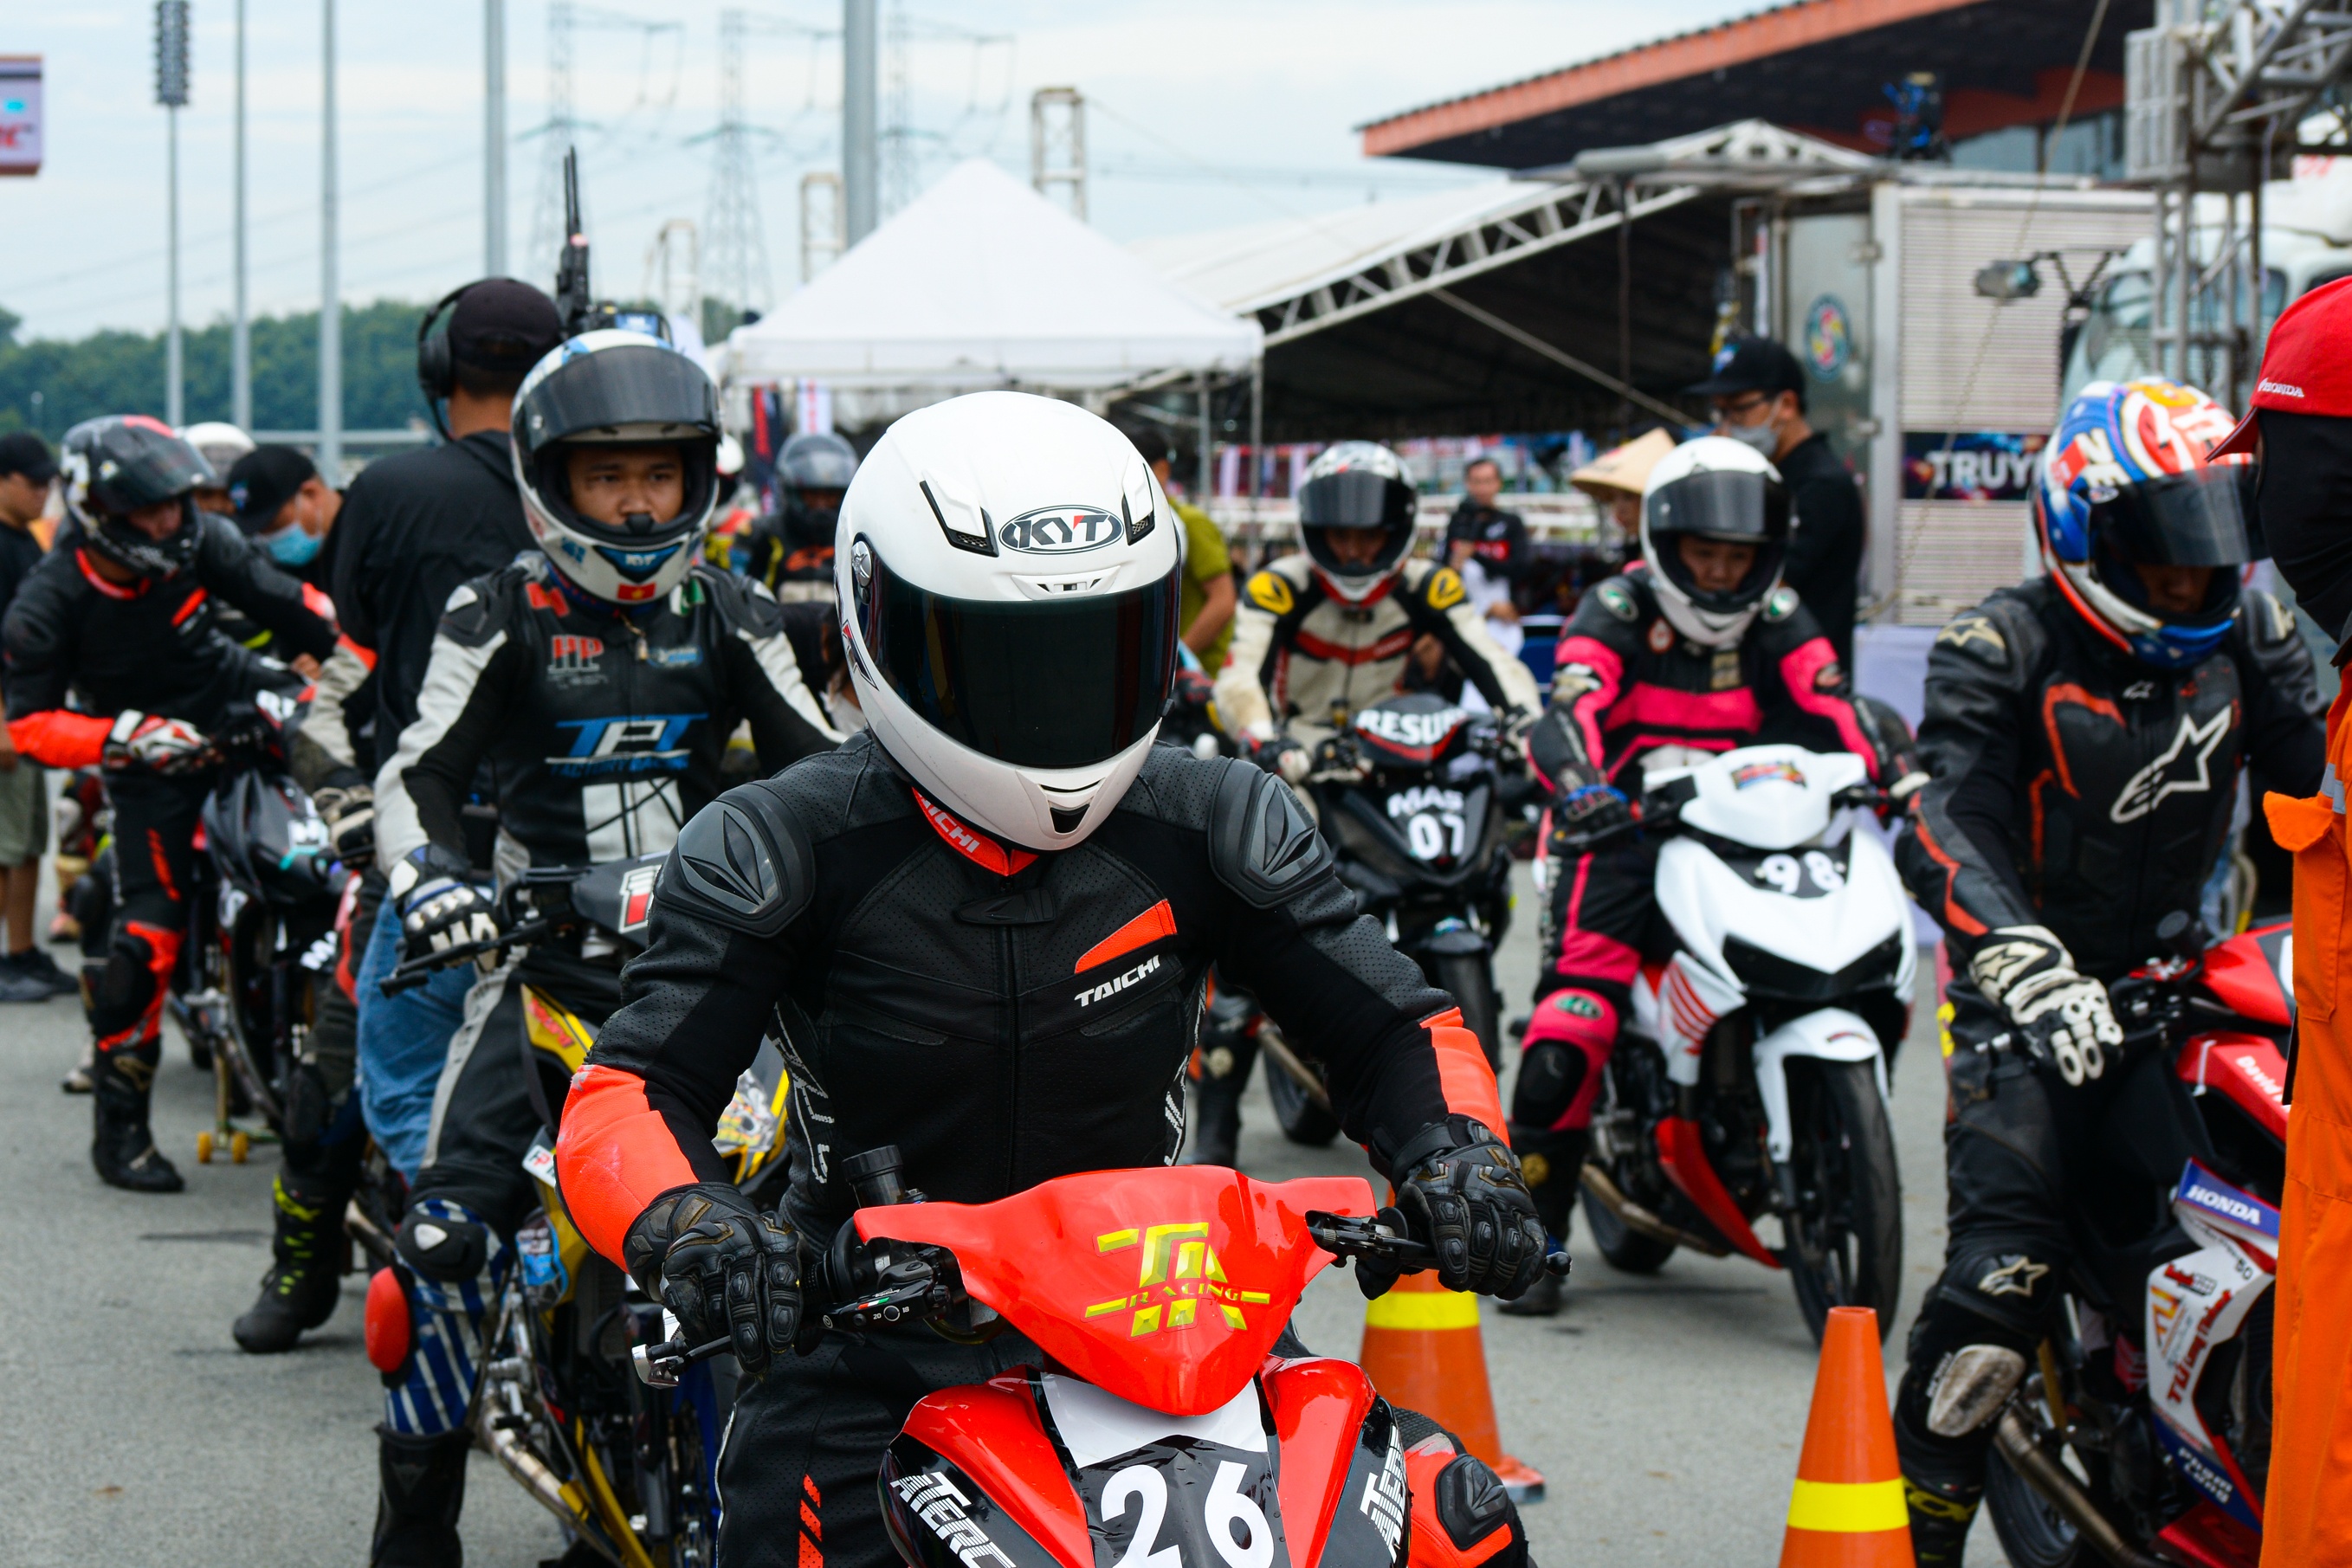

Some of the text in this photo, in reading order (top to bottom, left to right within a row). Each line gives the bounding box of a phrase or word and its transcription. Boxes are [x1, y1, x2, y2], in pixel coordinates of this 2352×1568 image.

[2262, 382, 2305, 398] HONDA
[1011, 513, 1112, 551] KYT
[1408, 812, 1466, 861] 07
[1760, 850, 1845, 894] 98
[1074, 954, 1160, 1007] TAICHI
[2187, 1184, 2261, 1226] HONDA
[1129, 1282, 1238, 1308] RACING
[1100, 1459, 1276, 1568] 26
